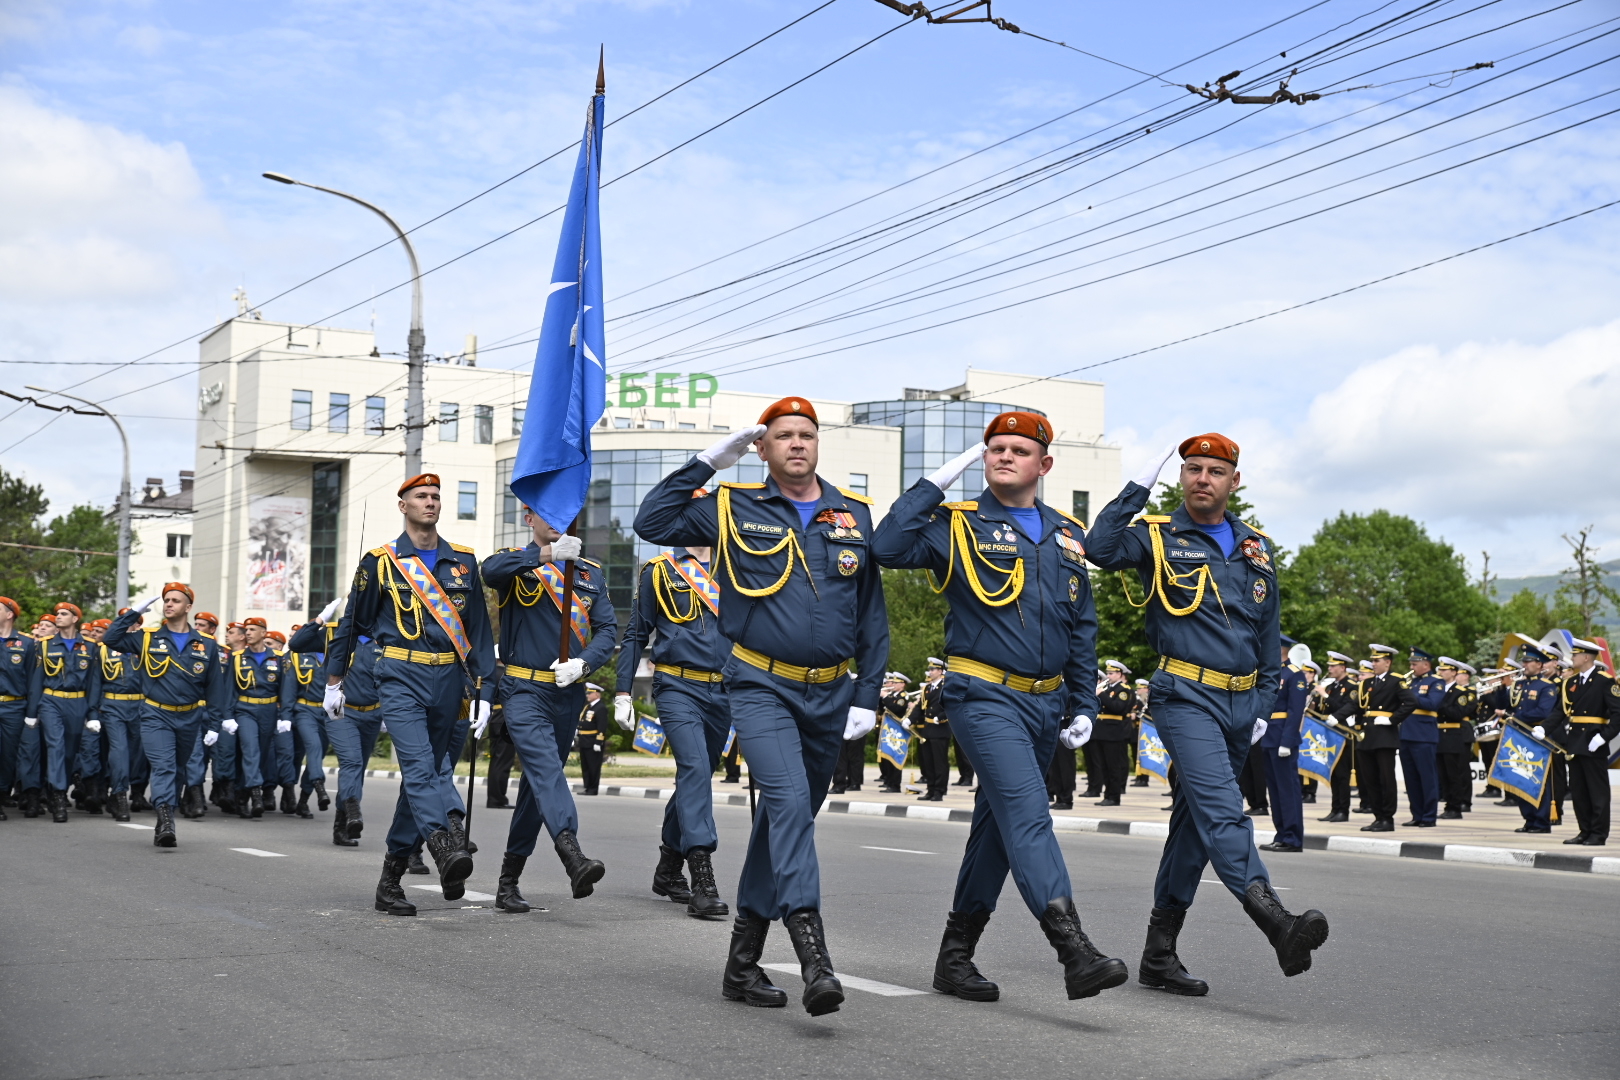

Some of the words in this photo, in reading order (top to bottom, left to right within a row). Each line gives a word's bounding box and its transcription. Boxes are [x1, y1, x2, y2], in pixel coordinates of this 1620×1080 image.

[605, 372, 718, 408] БЕР
[743, 522, 757, 530] МЧС
[757, 525, 782, 533] РОССИИ
[992, 544, 1017, 552] РОССИИ
